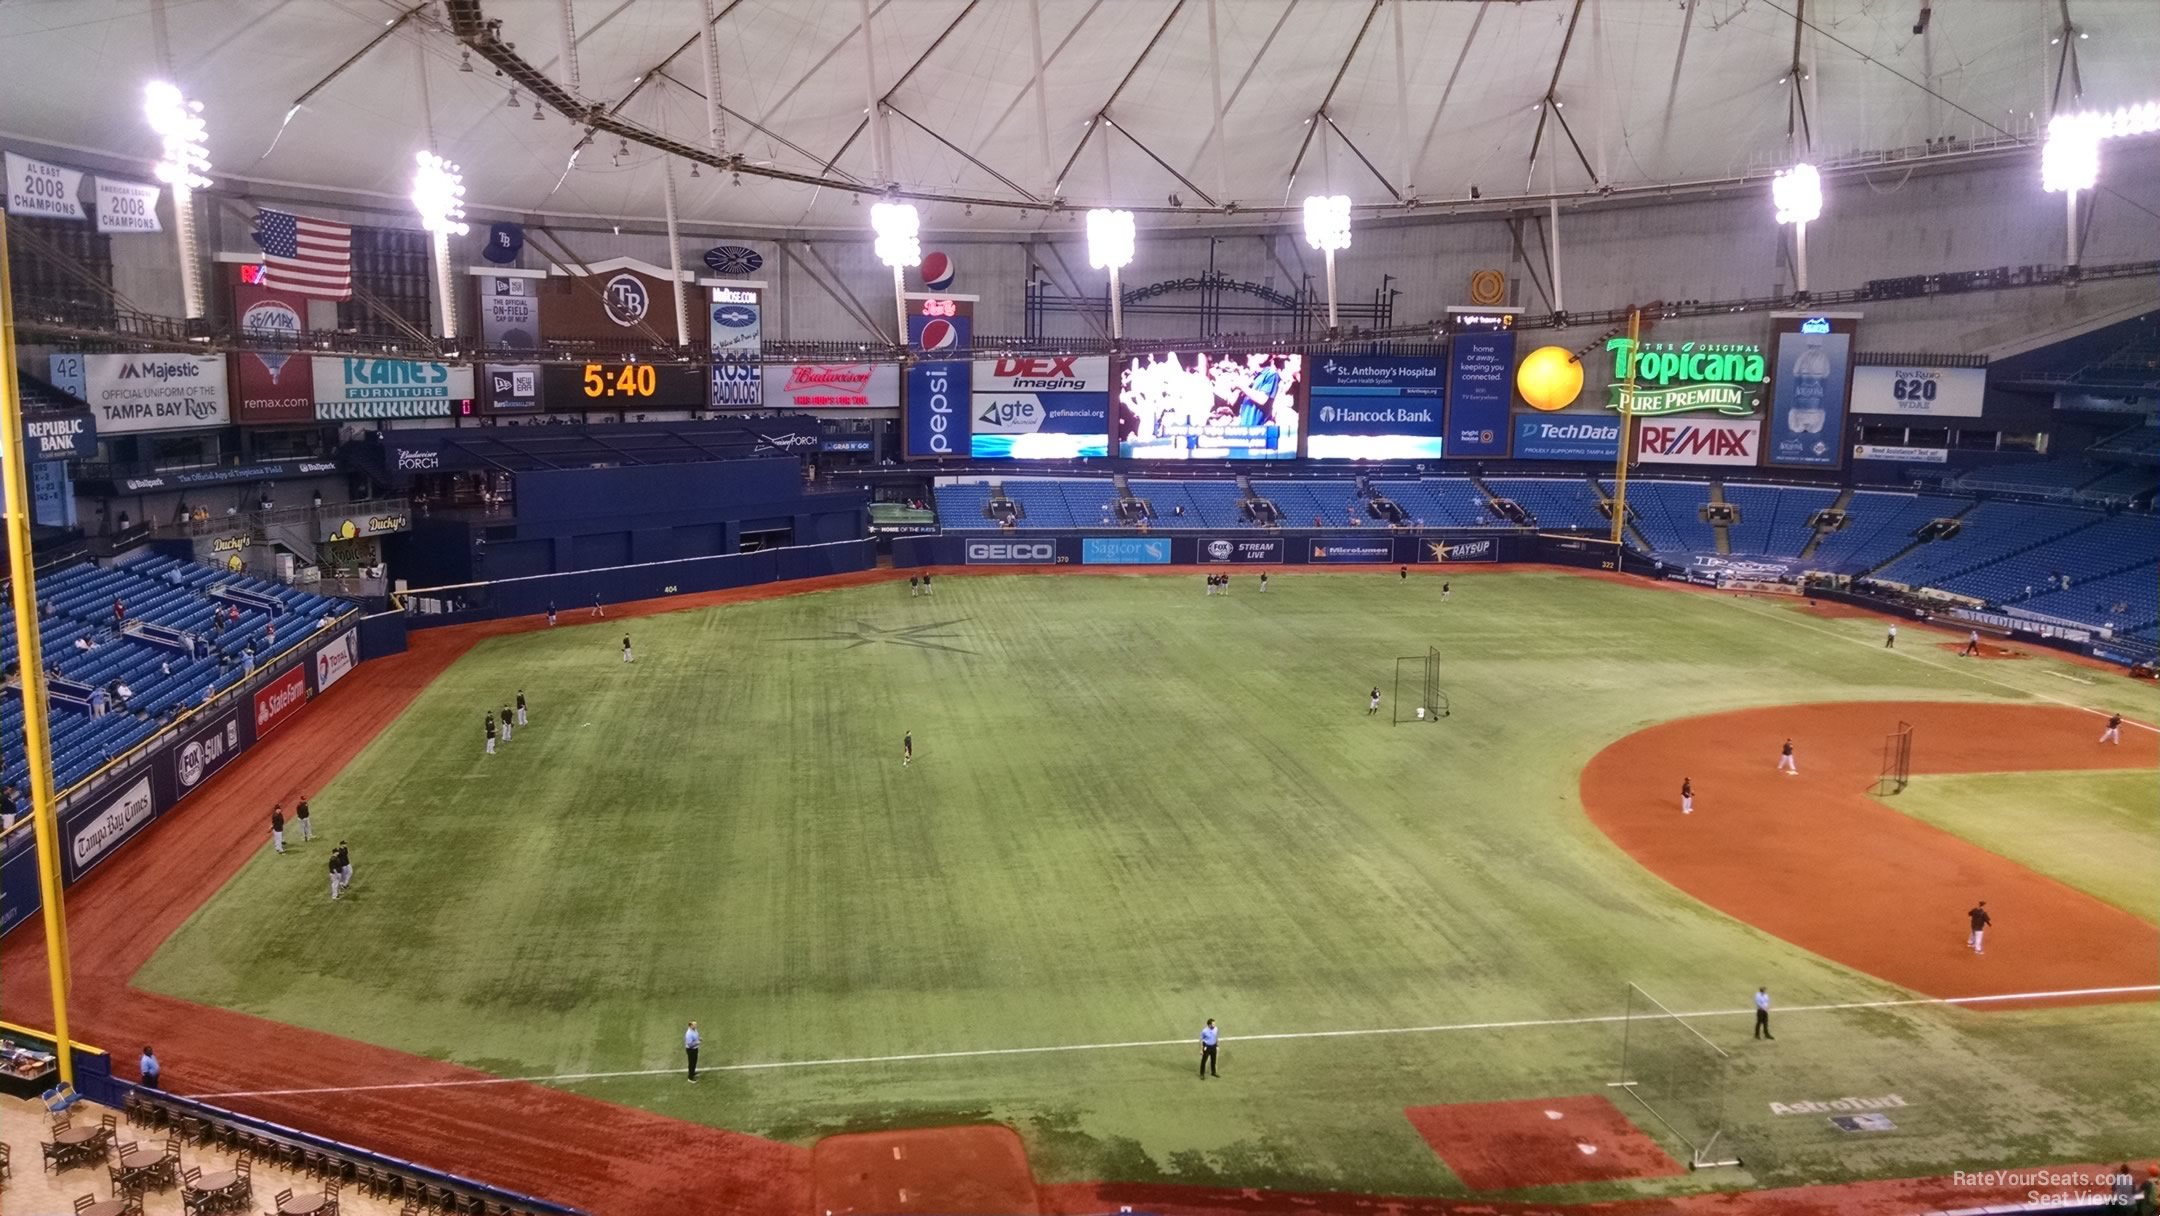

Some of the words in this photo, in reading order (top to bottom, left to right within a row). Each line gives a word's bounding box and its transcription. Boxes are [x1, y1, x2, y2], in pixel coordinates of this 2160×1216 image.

[27, 163, 38, 173] AL
[40, 165, 61, 177] EAST
[25, 175, 64, 199] 2008
[14, 194, 75, 215] CHAMPIONS
[112, 197, 145, 216] 2008
[103, 215, 154, 229] CHAMPIONS
[1121, 277, 1238, 305] TROPICANA
[1243, 281, 1297, 311] FIELD
[493, 306, 529, 315] ON-FIELD
[1473, 345, 1494, 353] home
[1645, 343, 1674, 351] THE
[1700, 344, 1760, 353] ORIGINAL
[57, 358, 77, 377] 42
[993, 357, 1079, 377] DEX
[1461, 363, 1490, 373] keeping
[1606, 338, 1765, 385] Tropicana
[142, 362, 199, 382] Majestic
[1338, 366, 1350, 376] St.
[1352, 366, 1397, 378] Anthony's
[1398, 367, 1437, 378] Hospital
[584, 364, 656, 397] 5:40
[1013, 377, 1086, 390] imaging
[102, 389, 143, 400] OFFICIAL
[144, 387, 184, 398] UNIFORM
[186, 387, 198, 396] OF
[200, 386, 215, 395] THE
[350, 387, 443, 398] FURNITURE
[712, 381, 760, 404] RADIOLOGY
[1893, 379, 1937, 401] 620
[244, 398, 309, 408] remax.com
[1619, 393, 1662, 411] PURE
[1665, 388, 1742, 410] PREMIUM
[103, 405, 153, 419] TAMPA
[157, 402, 182, 417] BAY
[926, 371, 952, 452] pepsi
[1001, 401, 1034, 421] gte
[1049, 409, 1105, 418] gtefinancial.org
[1336, 408, 1396, 422] Hancock
[1397, 408, 1432, 422] Bank
[28, 419, 83, 437] REPUBLIC
[40, 435, 74, 451] BANK
[791, 436, 818, 446] PORCH
[1641, 426, 1752, 456] RE/MAX
[397, 449, 437, 459] Budweiser
[307, 463, 335, 472] Ballpark
[399, 458, 439, 469] PORCH
[136, 477, 165, 489] Ballpark
[369, 514, 406, 532] Ducky's
[213, 533, 250, 552] Ducky's
[1091, 541, 1142, 558] Sagicor
[1238, 543, 1274, 551] STREAM
[1452, 540, 1490, 556] RAYSUP
[969, 544, 1052, 560] GEICO
[1247, 551, 1265, 559] LIVE
[1601, 561, 1614, 569] 322
[665, 585, 677, 593] 404
[205, 732, 223, 765] SUN
[184, 748, 199, 772] FOX
[78, 826, 107, 858] Tampa
[106, 815, 124, 835] Bay
[124, 795, 149, 822] Times
[1769, 1094, 1908, 1115] AstroTurf
